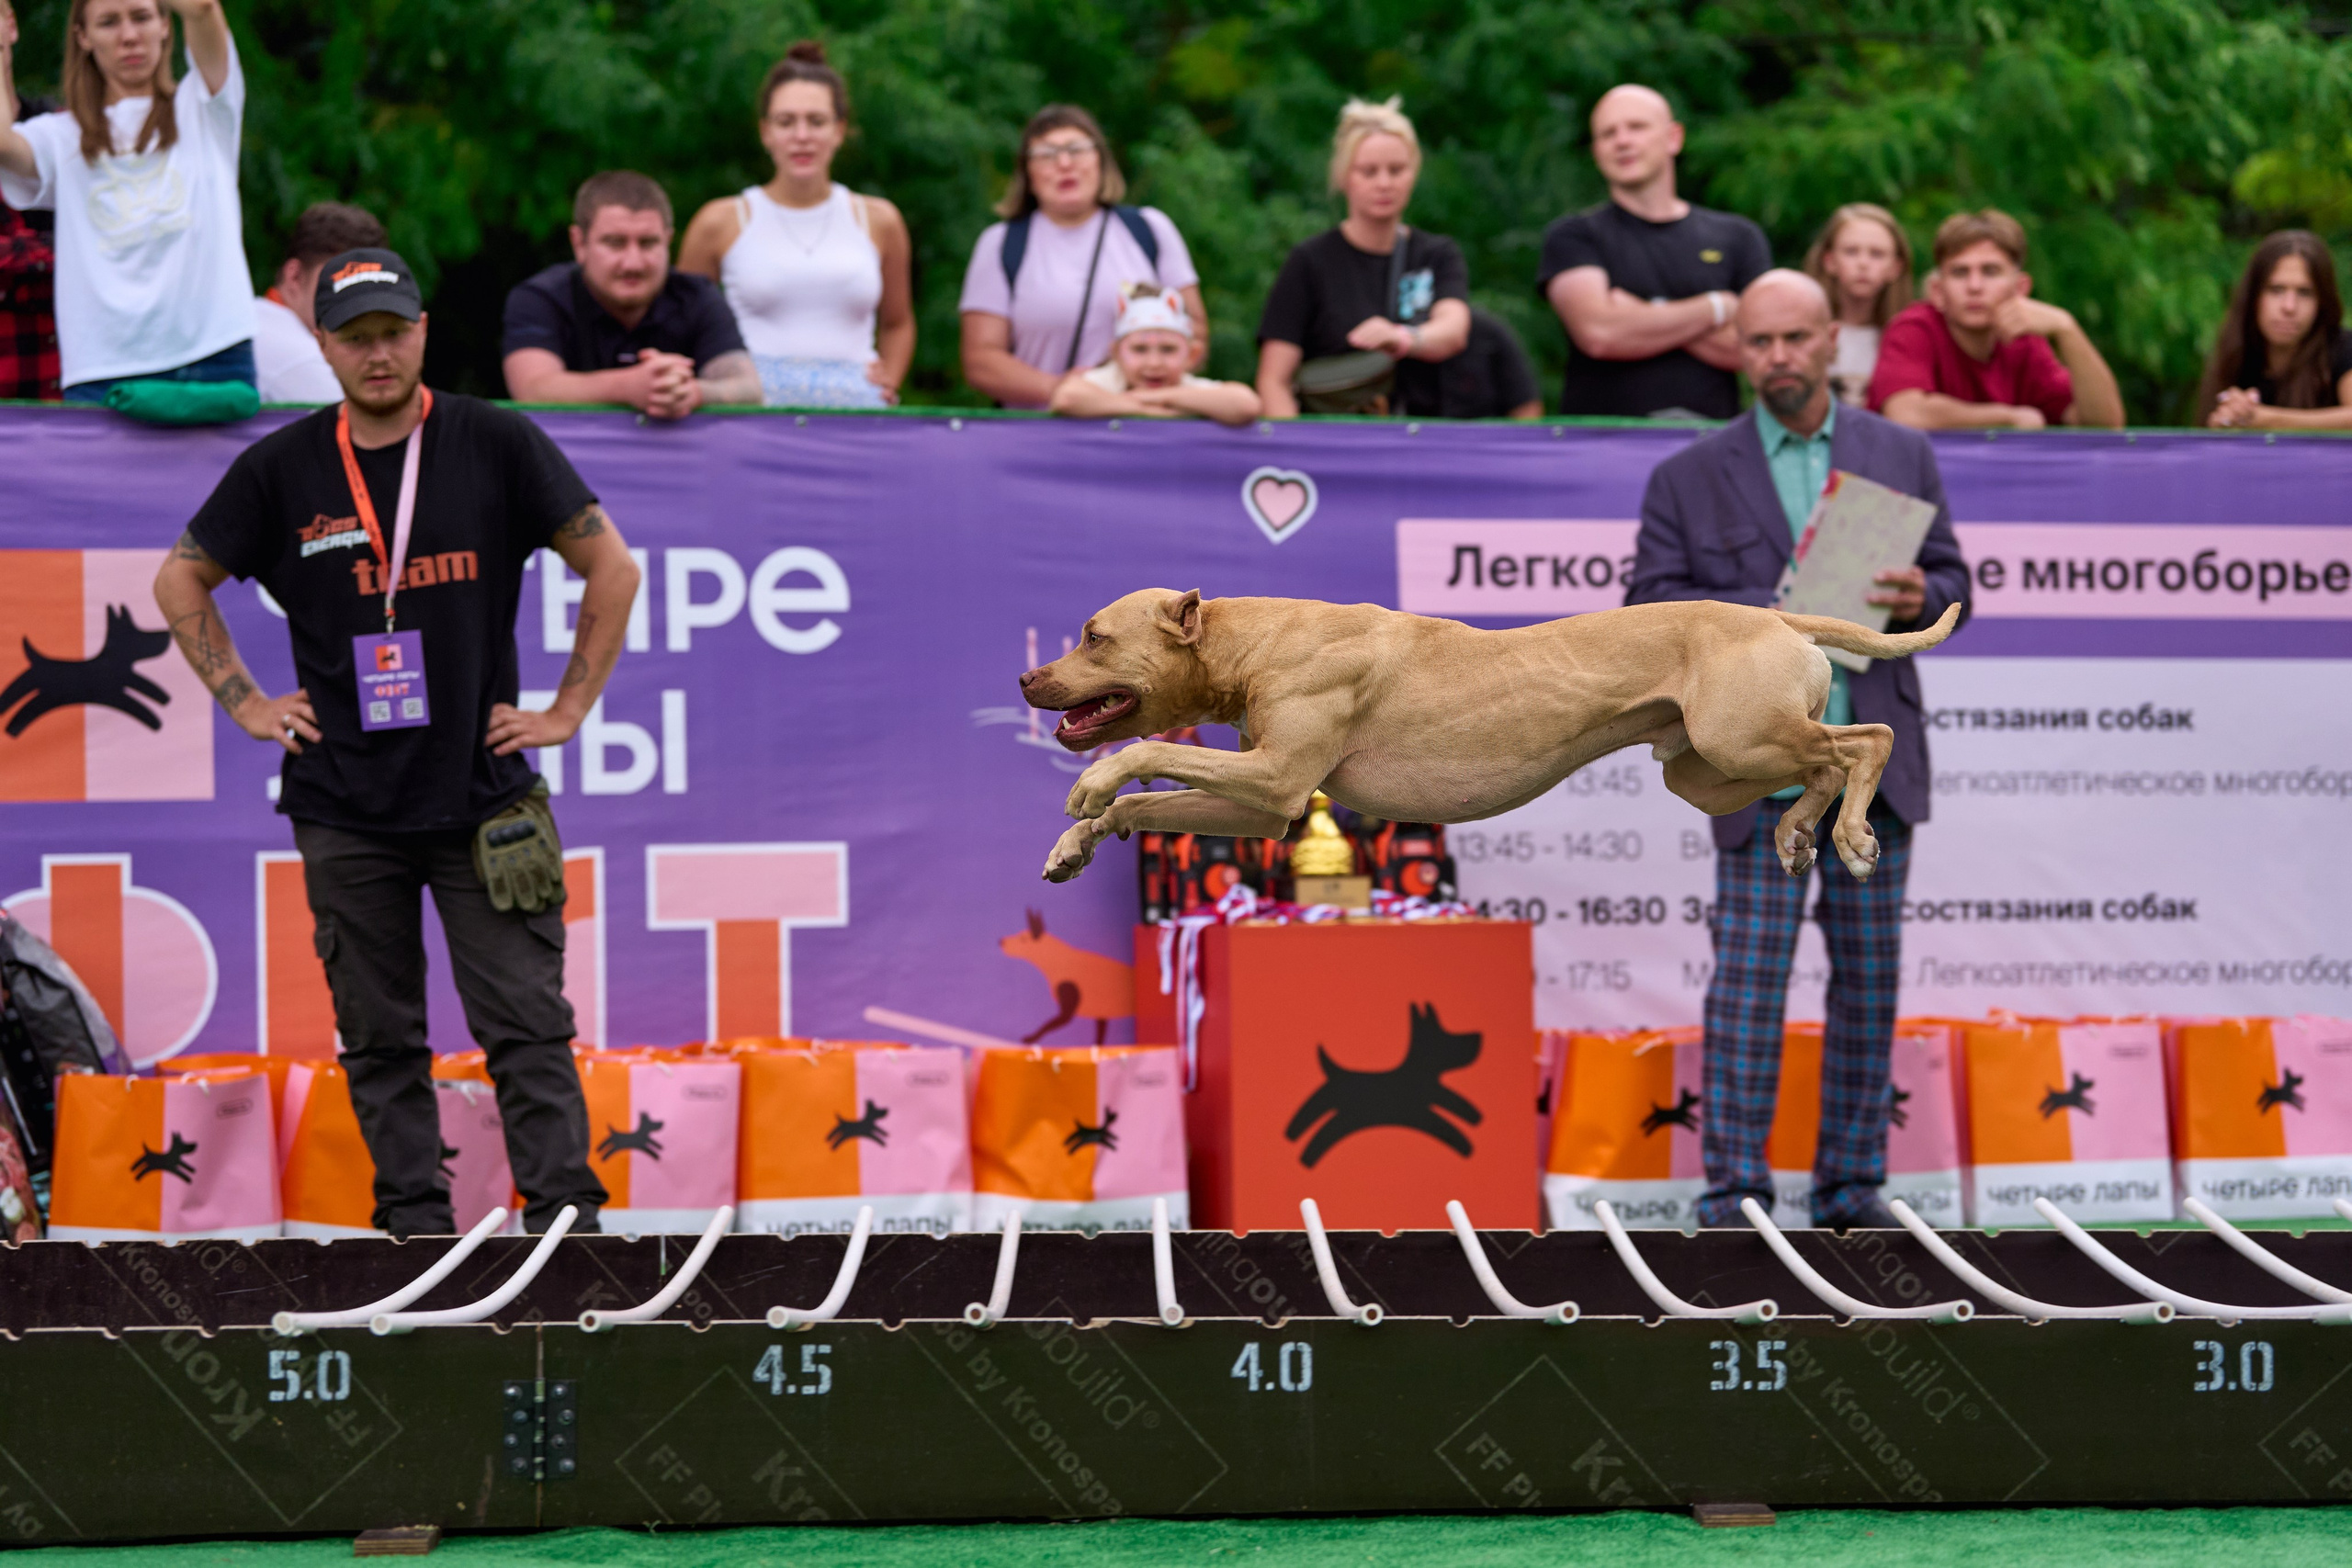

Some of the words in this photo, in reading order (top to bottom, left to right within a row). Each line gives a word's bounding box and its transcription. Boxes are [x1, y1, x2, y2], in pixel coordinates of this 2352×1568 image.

[2022, 547, 2351, 603] многоборье
[2097, 703, 2194, 730] собак
[1932, 770, 2206, 796] егкоатлетическое
[1455, 829, 1536, 863] 13:45
[1563, 829, 1644, 862] 14:30
[1575, 897, 1667, 926] 16:30
[2101, 893, 2198, 921] собак
[1567, 960, 1633, 991] 17:15
[268, 1350, 351, 1401] 5.0
[752, 1344, 832, 1395] 4.5
[1230, 1342, 1313, 1392] 4.0
[1710, 1340, 1788, 1391] 3.5
[2193, 1340, 2275, 1392] 3.0
